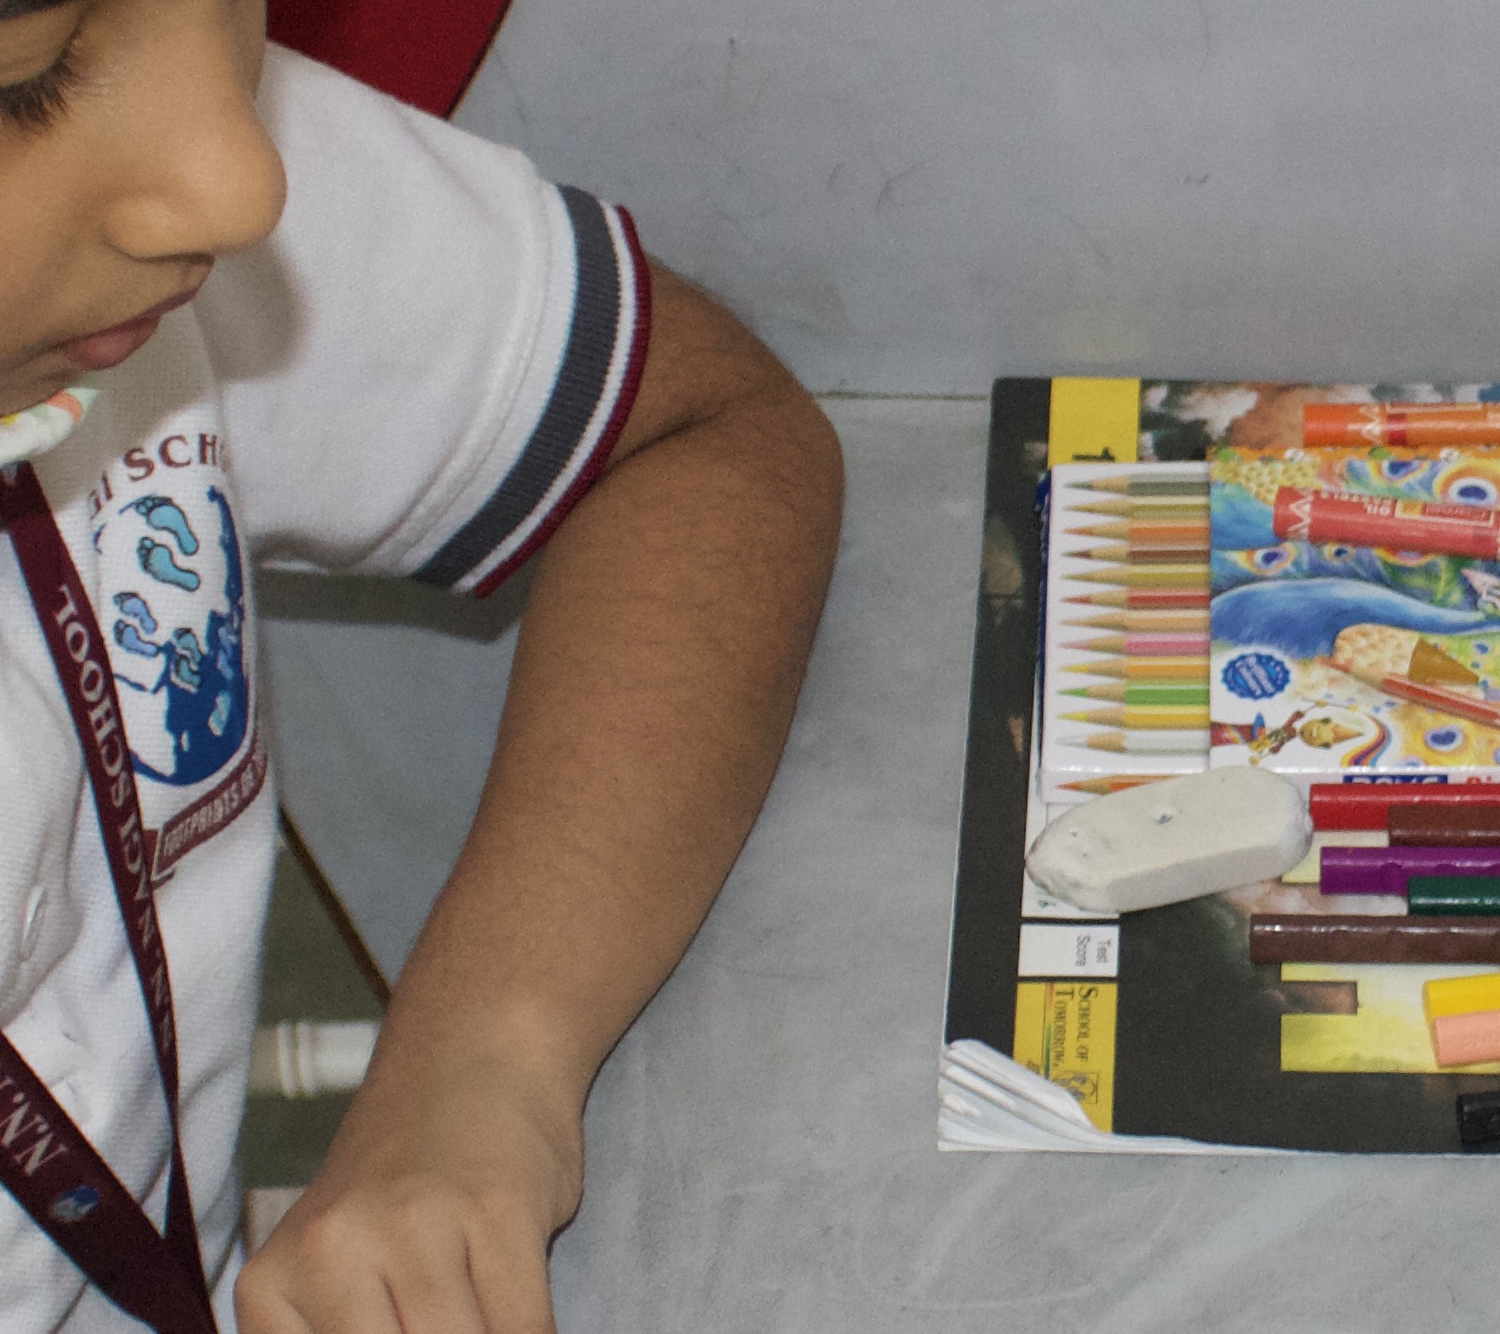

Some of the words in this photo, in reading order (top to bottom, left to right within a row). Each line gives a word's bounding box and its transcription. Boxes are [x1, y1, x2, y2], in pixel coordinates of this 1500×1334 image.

[56, 583, 134, 808] SCHOOL
[1076, 935, 1091, 968] Score
[1096, 938, 1111, 964] Test
